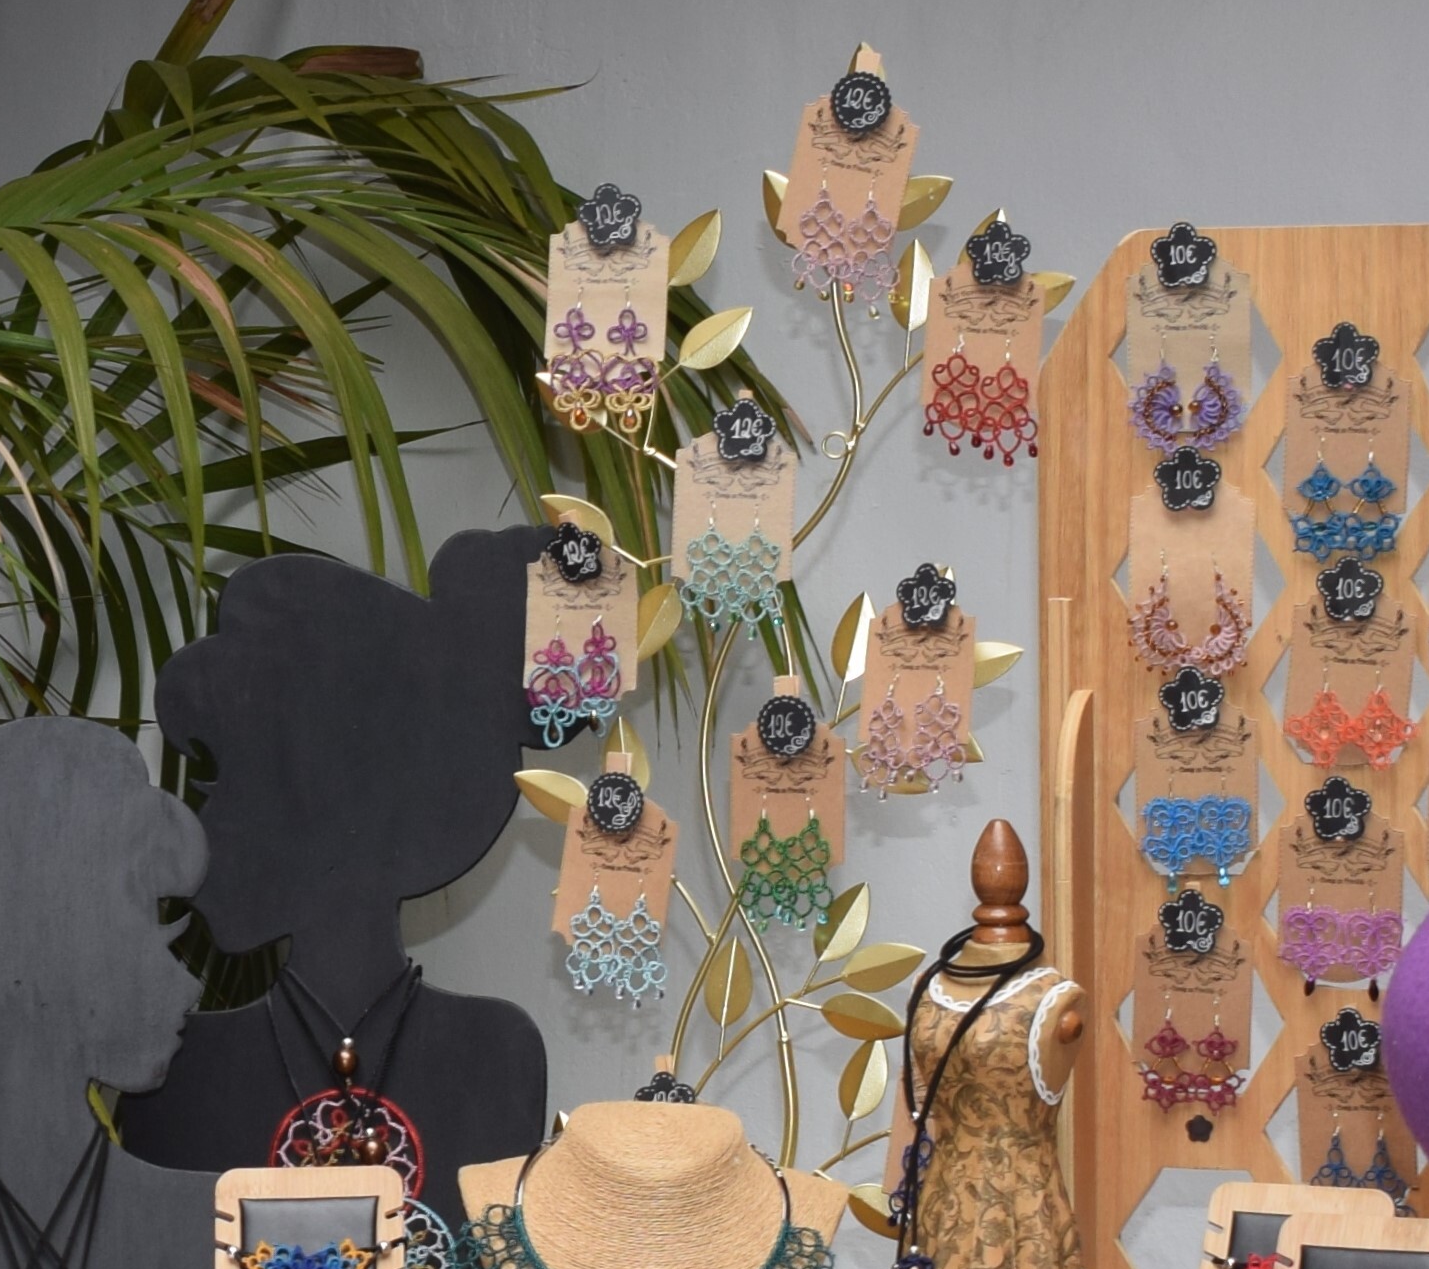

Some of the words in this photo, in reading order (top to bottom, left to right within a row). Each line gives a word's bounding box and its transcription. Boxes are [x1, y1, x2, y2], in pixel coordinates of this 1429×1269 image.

[841, 87, 875, 111] 12€
[594, 202, 624, 229] 12€
[983, 240, 1012, 265] 12€
[1169, 244, 1197, 266] 10€
[1330, 347, 1365, 373] 10€
[730, 417, 763, 439] 12€
[1175, 469, 1203, 490] 10€
[562, 537, 590, 566] 12€
[911, 585, 941, 609] 12€
[1335, 577, 1365, 601] 10€
[1179, 689, 1209, 713] 10€
[768, 712, 795, 740] 12€
[597, 786, 624, 809] 12€
[1323, 797, 1355, 819] 10€
[1175, 909, 1207, 936] 10€
[1341, 1029, 1370, 1052] 10€
